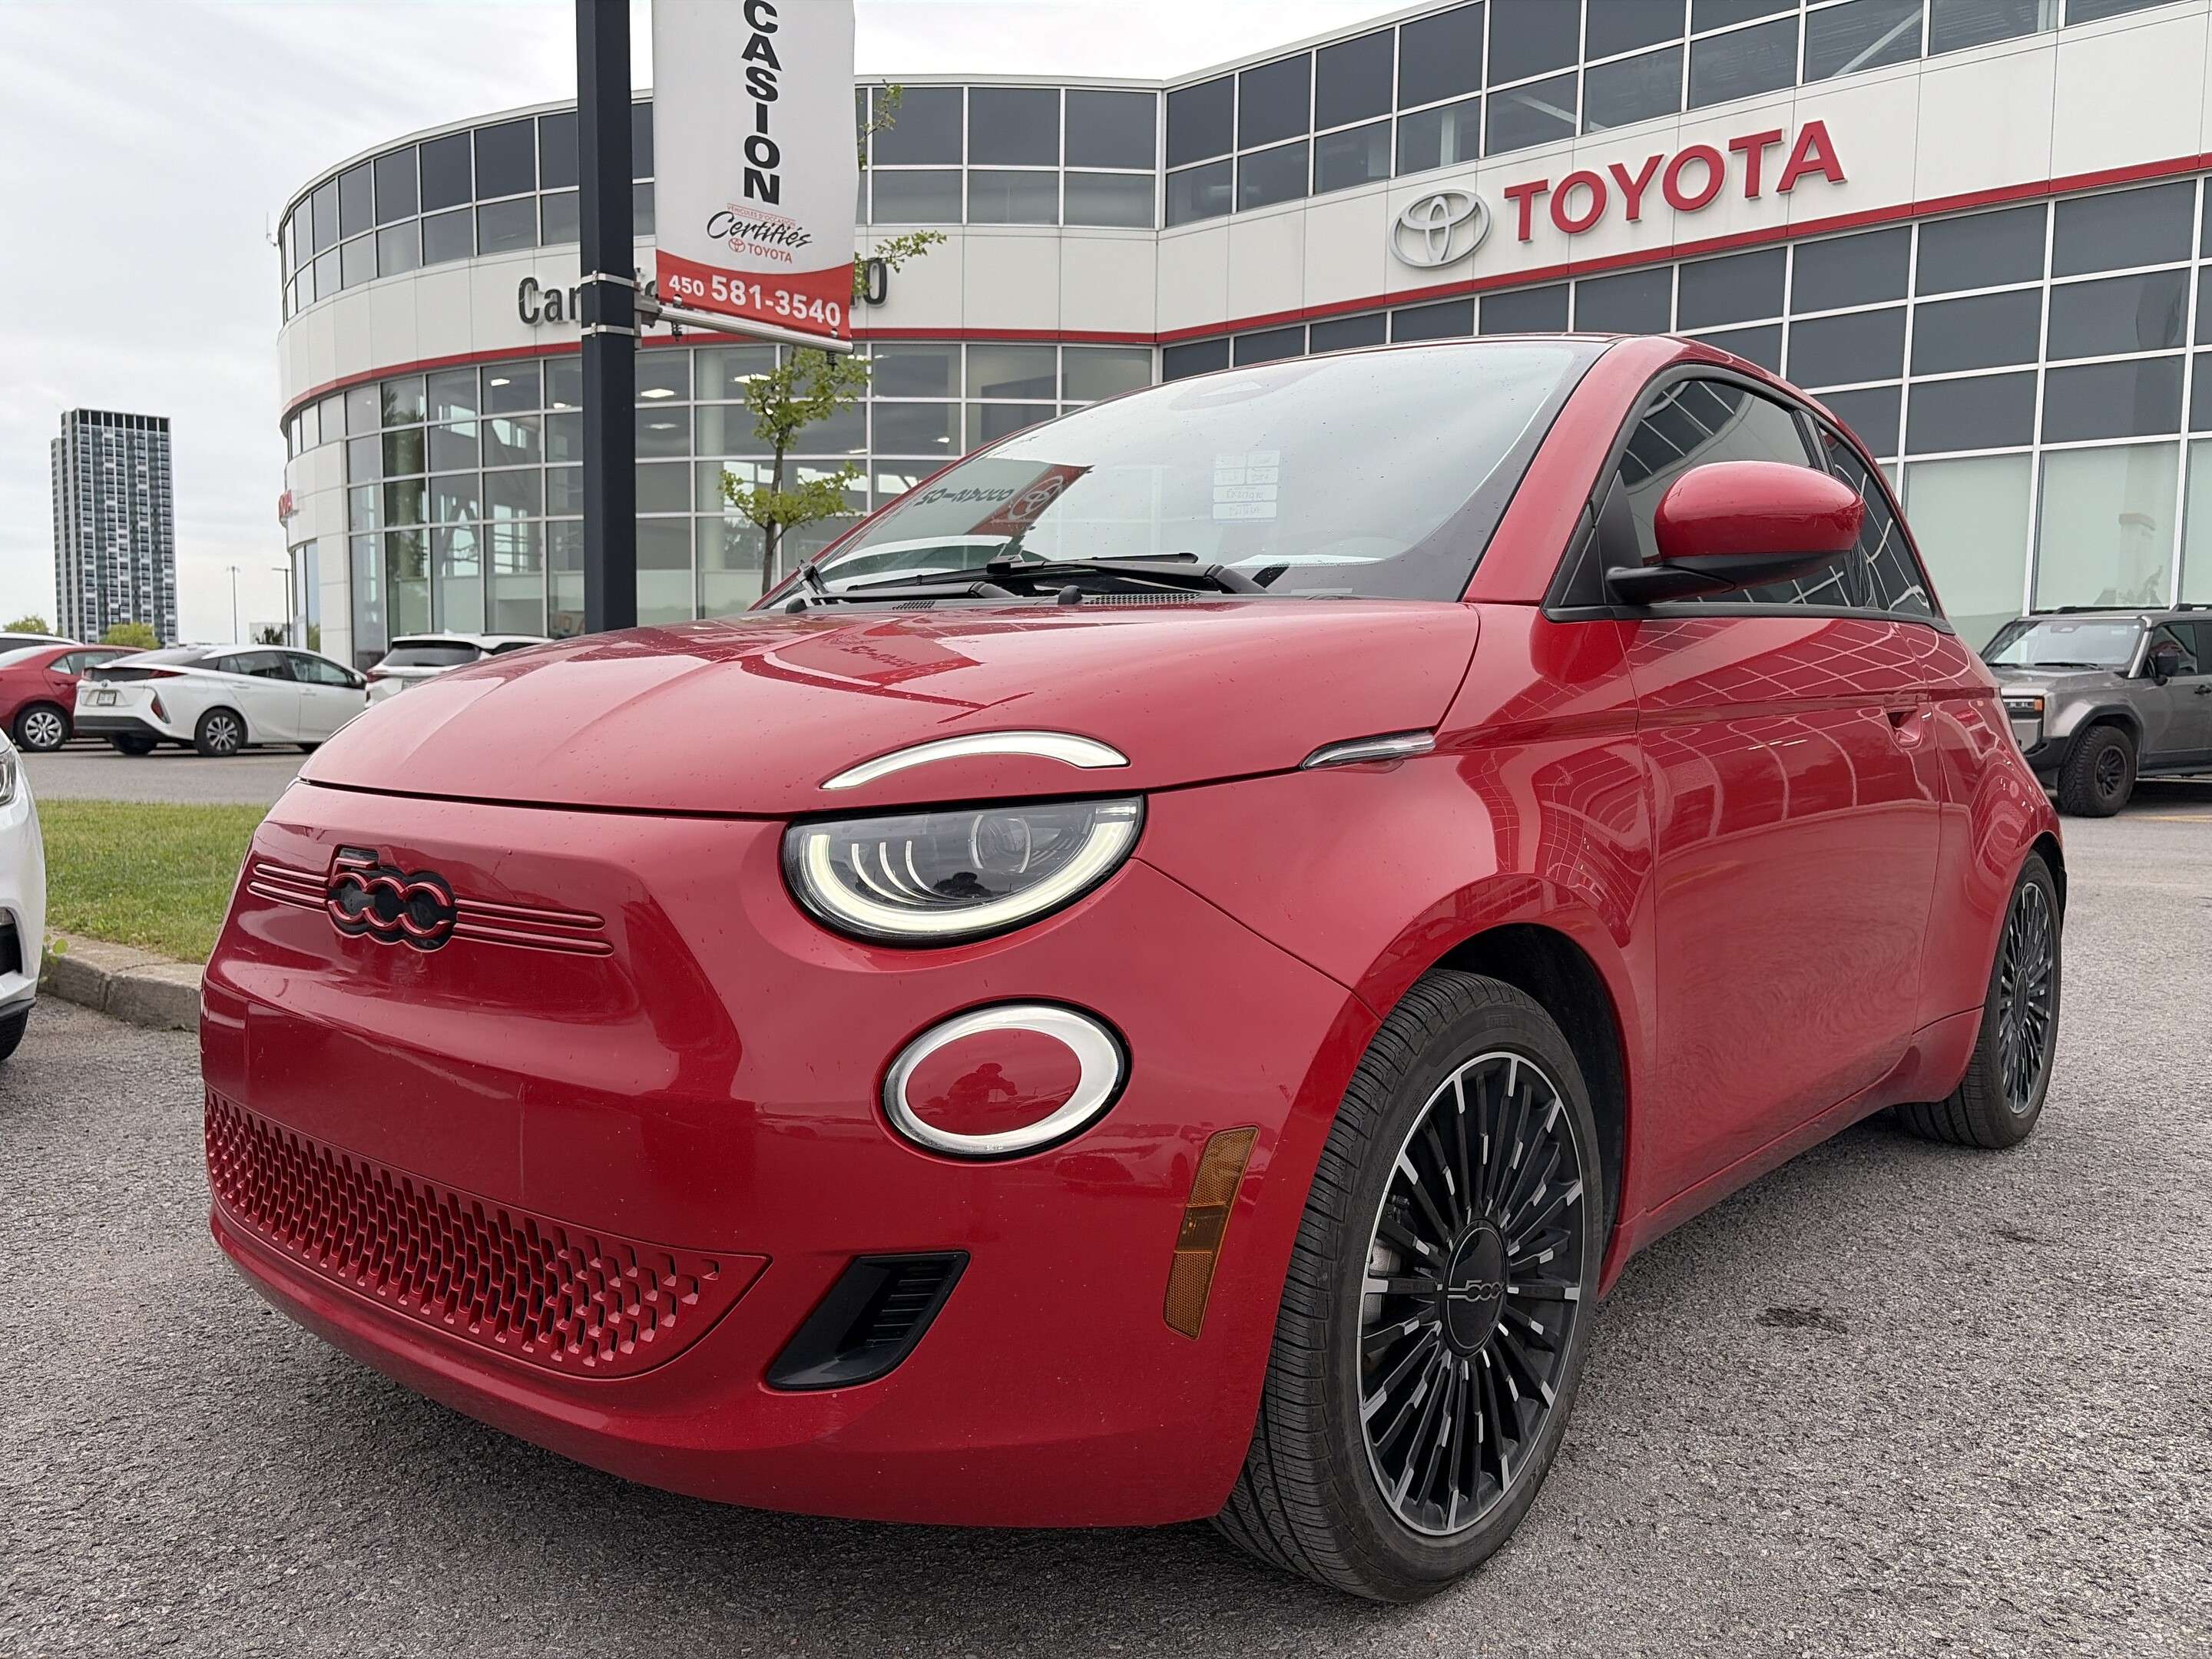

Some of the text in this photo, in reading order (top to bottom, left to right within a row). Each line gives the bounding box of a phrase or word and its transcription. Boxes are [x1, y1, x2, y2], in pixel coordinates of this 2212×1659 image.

[1504, 120, 1847, 243] TOYOTA
[707, 210, 813, 248] Certifiés
[747, 243, 793, 263] TOYOTA
[669, 275, 841, 327] 450 581-3540
[327, 851, 453, 943] 500
